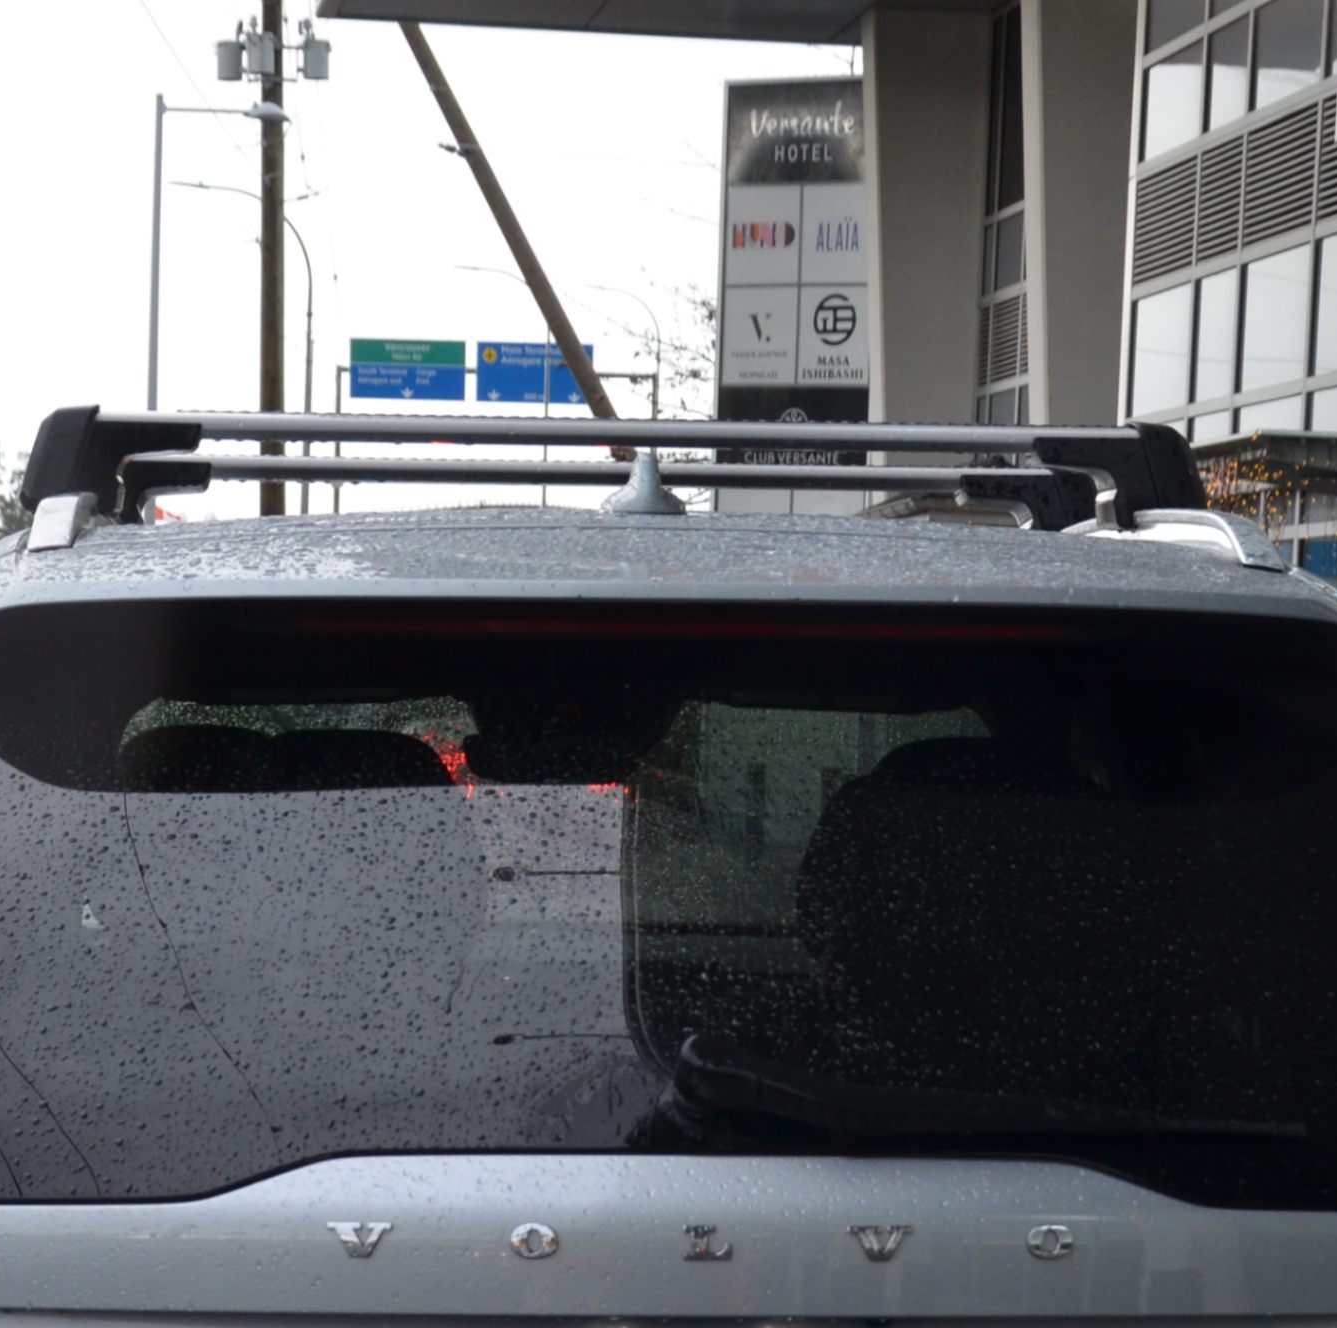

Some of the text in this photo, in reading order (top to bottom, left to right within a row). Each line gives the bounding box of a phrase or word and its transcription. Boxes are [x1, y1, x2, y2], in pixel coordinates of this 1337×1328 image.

[750, 100, 857, 138] Versante
[774, 143, 833, 163] HOTEL
[816, 216, 859, 251] ALAÏA
[384, 342, 431, 352] Vancouver
[816, 355, 850, 367] MASA
[802, 368, 863, 380] ISHIBASHI
[744, 450, 839, 465] CLUB VERSANTE
[326, 1221, 1075, 1262] VOLVO
